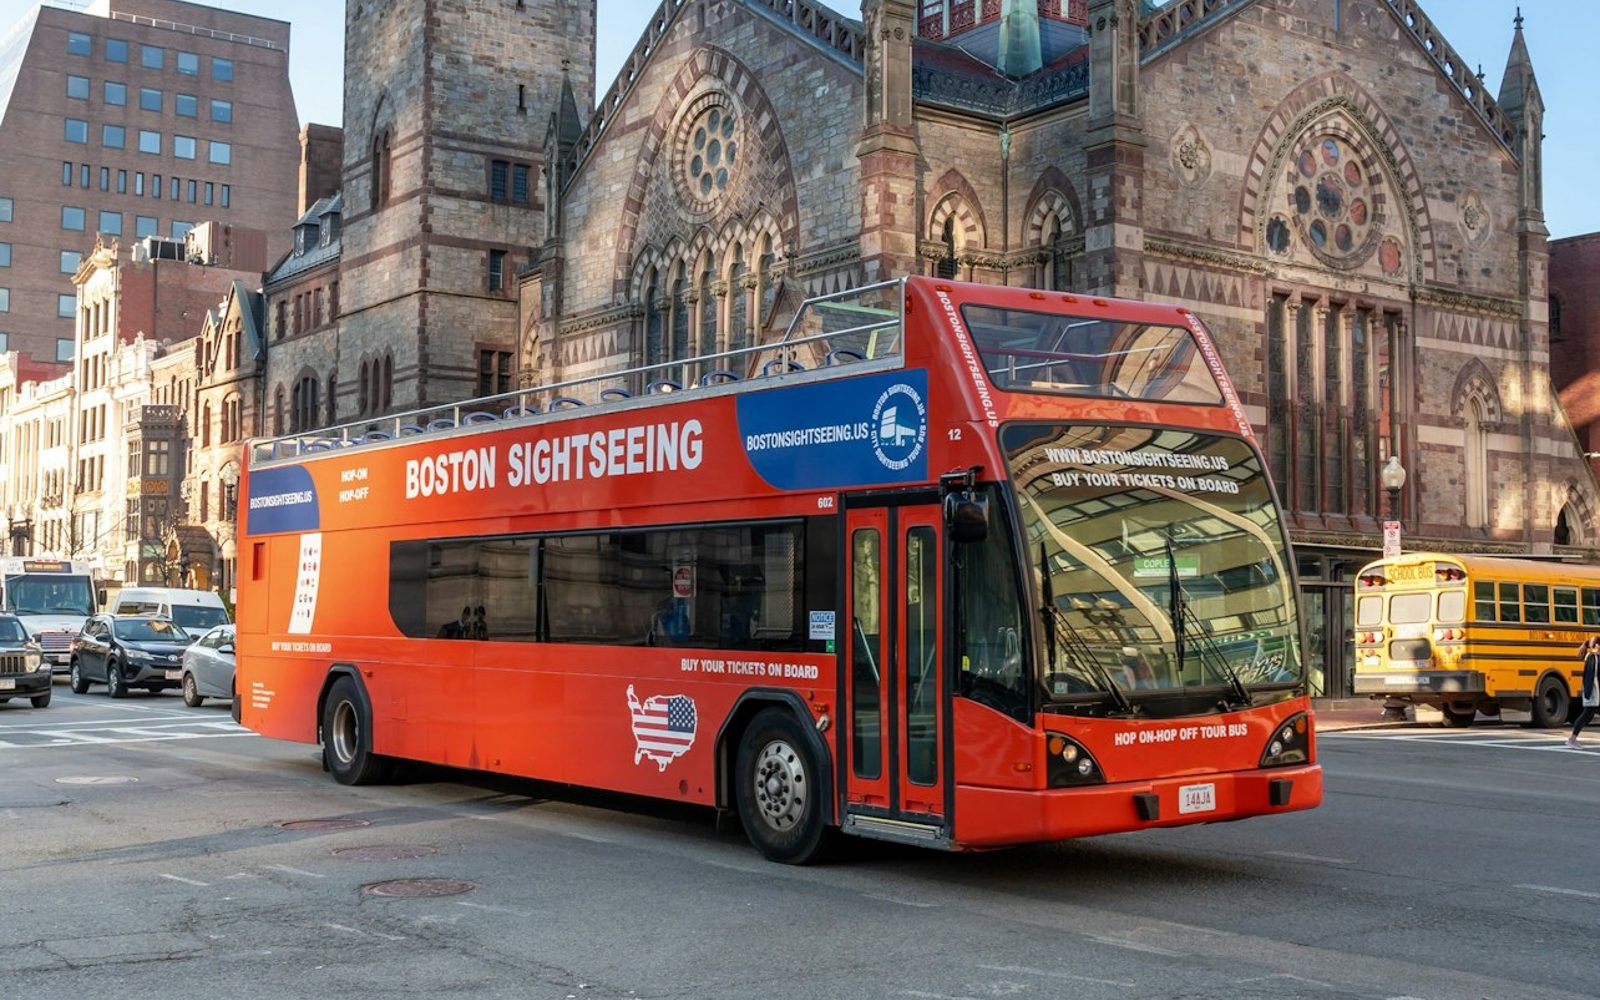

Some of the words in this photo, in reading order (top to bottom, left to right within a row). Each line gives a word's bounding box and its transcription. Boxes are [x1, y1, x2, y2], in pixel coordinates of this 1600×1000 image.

[936, 291, 999, 428] BOSTONSIGHTSEEING.US
[746, 422, 869, 451] BOSTONSIGHTSEEING.US
[948, 429, 961, 440] 12
[406, 446, 497, 499] BOSTON
[507, 419, 703, 487] SIGHTSEEING
[1044, 448, 1229, 471] WWW.BOSTONSIGHTSEEING.US
[341, 467, 368, 482] HOP-ON
[1052, 472, 1080, 487] BUY
[1082, 472, 1120, 487] YOUR
[1121, 473, 1175, 488] TICKETS
[1177, 476, 1197, 490] ON
[1197, 477, 1239, 494] BOARD
[339, 487, 369, 503] HOP-OFF
[817, 497, 833, 508] 602
[1143, 558, 1176, 568] COPLE
[1388, 567, 1416, 580] SCHOOL
[1418, 565, 1434, 579] BUS
[681, 658, 699, 672] BUY
[701, 659, 725, 673] YOUR
[727, 660, 765, 676] TICKETS
[768, 664, 782, 676] ON
[784, 664, 819, 679] BOARD
[1114, 732, 1137, 746] HOP
[1139, 728, 1177, 744] ON-HOP
[1180, 727, 1198, 740] OFF
[1200, 725, 1226, 738] TOUR
[1228, 723, 1248, 736] BUS
